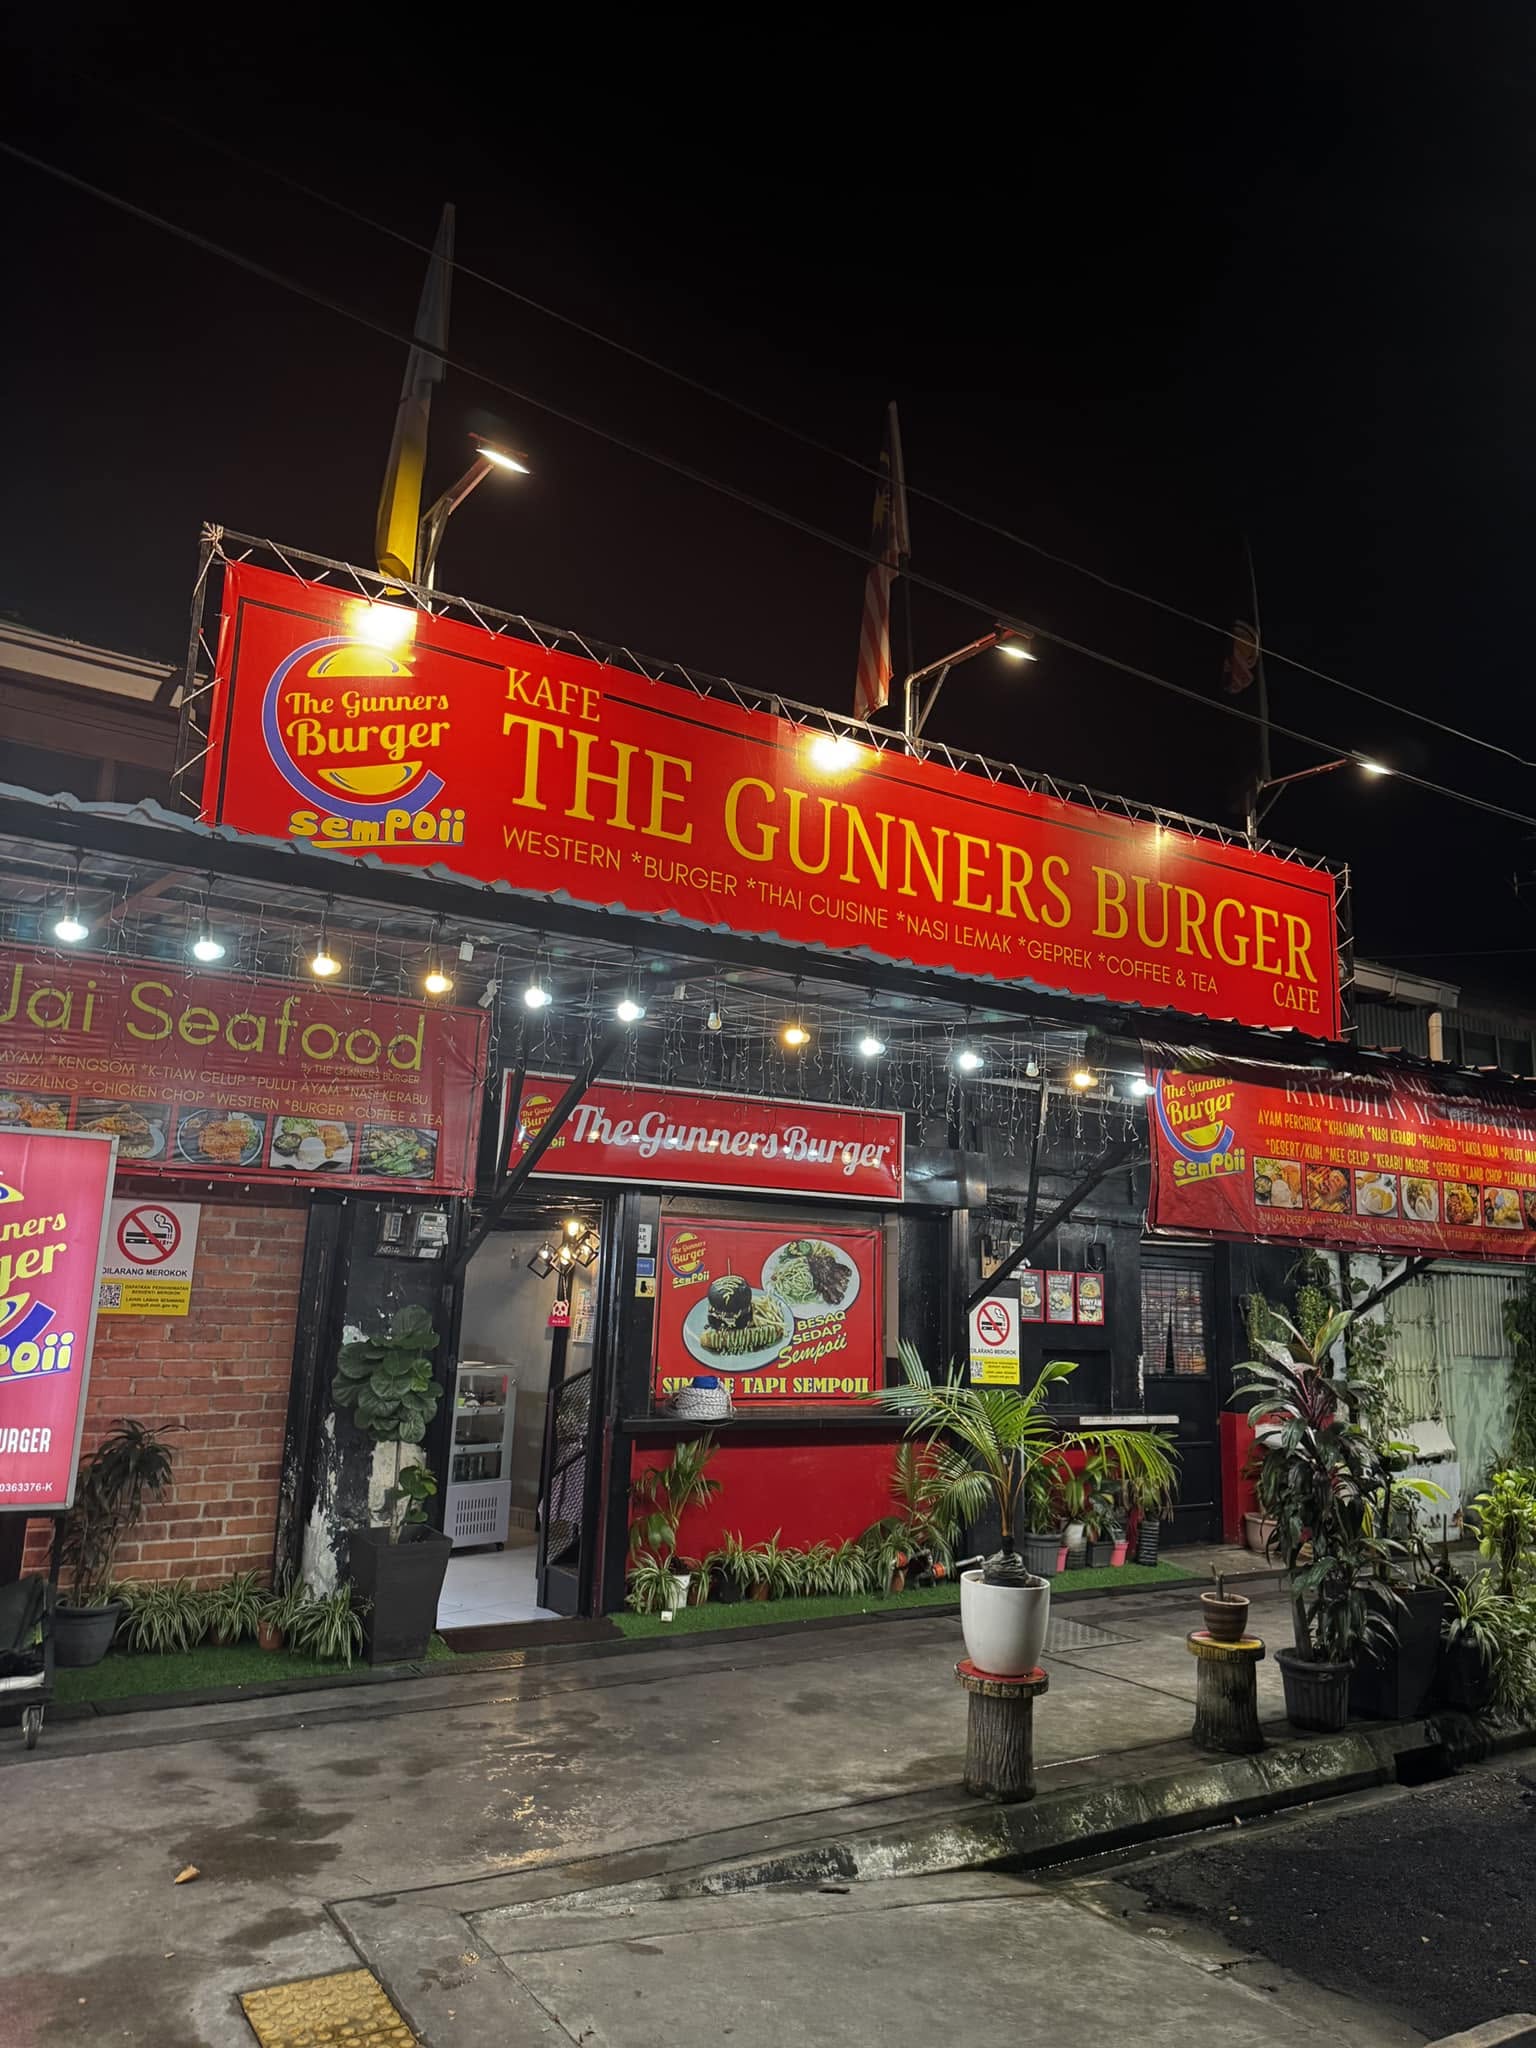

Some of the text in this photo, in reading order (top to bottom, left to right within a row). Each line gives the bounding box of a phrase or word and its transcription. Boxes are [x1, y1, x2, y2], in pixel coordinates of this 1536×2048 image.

[285, 690, 449, 719] The Gunners
[504, 666, 601, 723] KAFE
[286, 718, 451, 761] Burger
[503, 713, 1318, 984] THE GUNNERS BURGER
[504, 826, 622, 872] WESTERN
[809, 893, 889, 929] CUISINE
[954, 921, 1012, 955] LEMAK
[1176, 970, 1187, 988] &
[1191, 973, 1219, 995] TEA
[1272, 981, 1321, 1015] CAFE
[126, 980, 427, 1072] Seafood
[200, 1070, 246, 1087] CELUP
[301, 1081, 340, 1097] AYAM
[382, 1090, 429, 1106] KERABU
[383, 1071, 421, 1084] BURGER
[1163, 1083, 1187, 1100] The
[161, 1087, 206, 1103] CHOP
[408, 1112, 418, 1124] &
[422, 1112, 444, 1127] TEA
[1166, 1091, 1235, 1126] Burger
[568, 1104, 892, 1176] The Gunners Burger
[1258, 1109, 1283, 1128] AYAM
[1390, 1128, 1417, 1147] KERABU
[145, 1268, 188, 1277] MEROKOK
[792, 1323, 843, 1345] SEDAP
[796, 1310, 847, 1332] BESAQ
[777, 1333, 848, 1369] Sempoii
[741, 1377, 786, 1394] TAPI
[793, 1377, 870, 1394] SEMPOII
